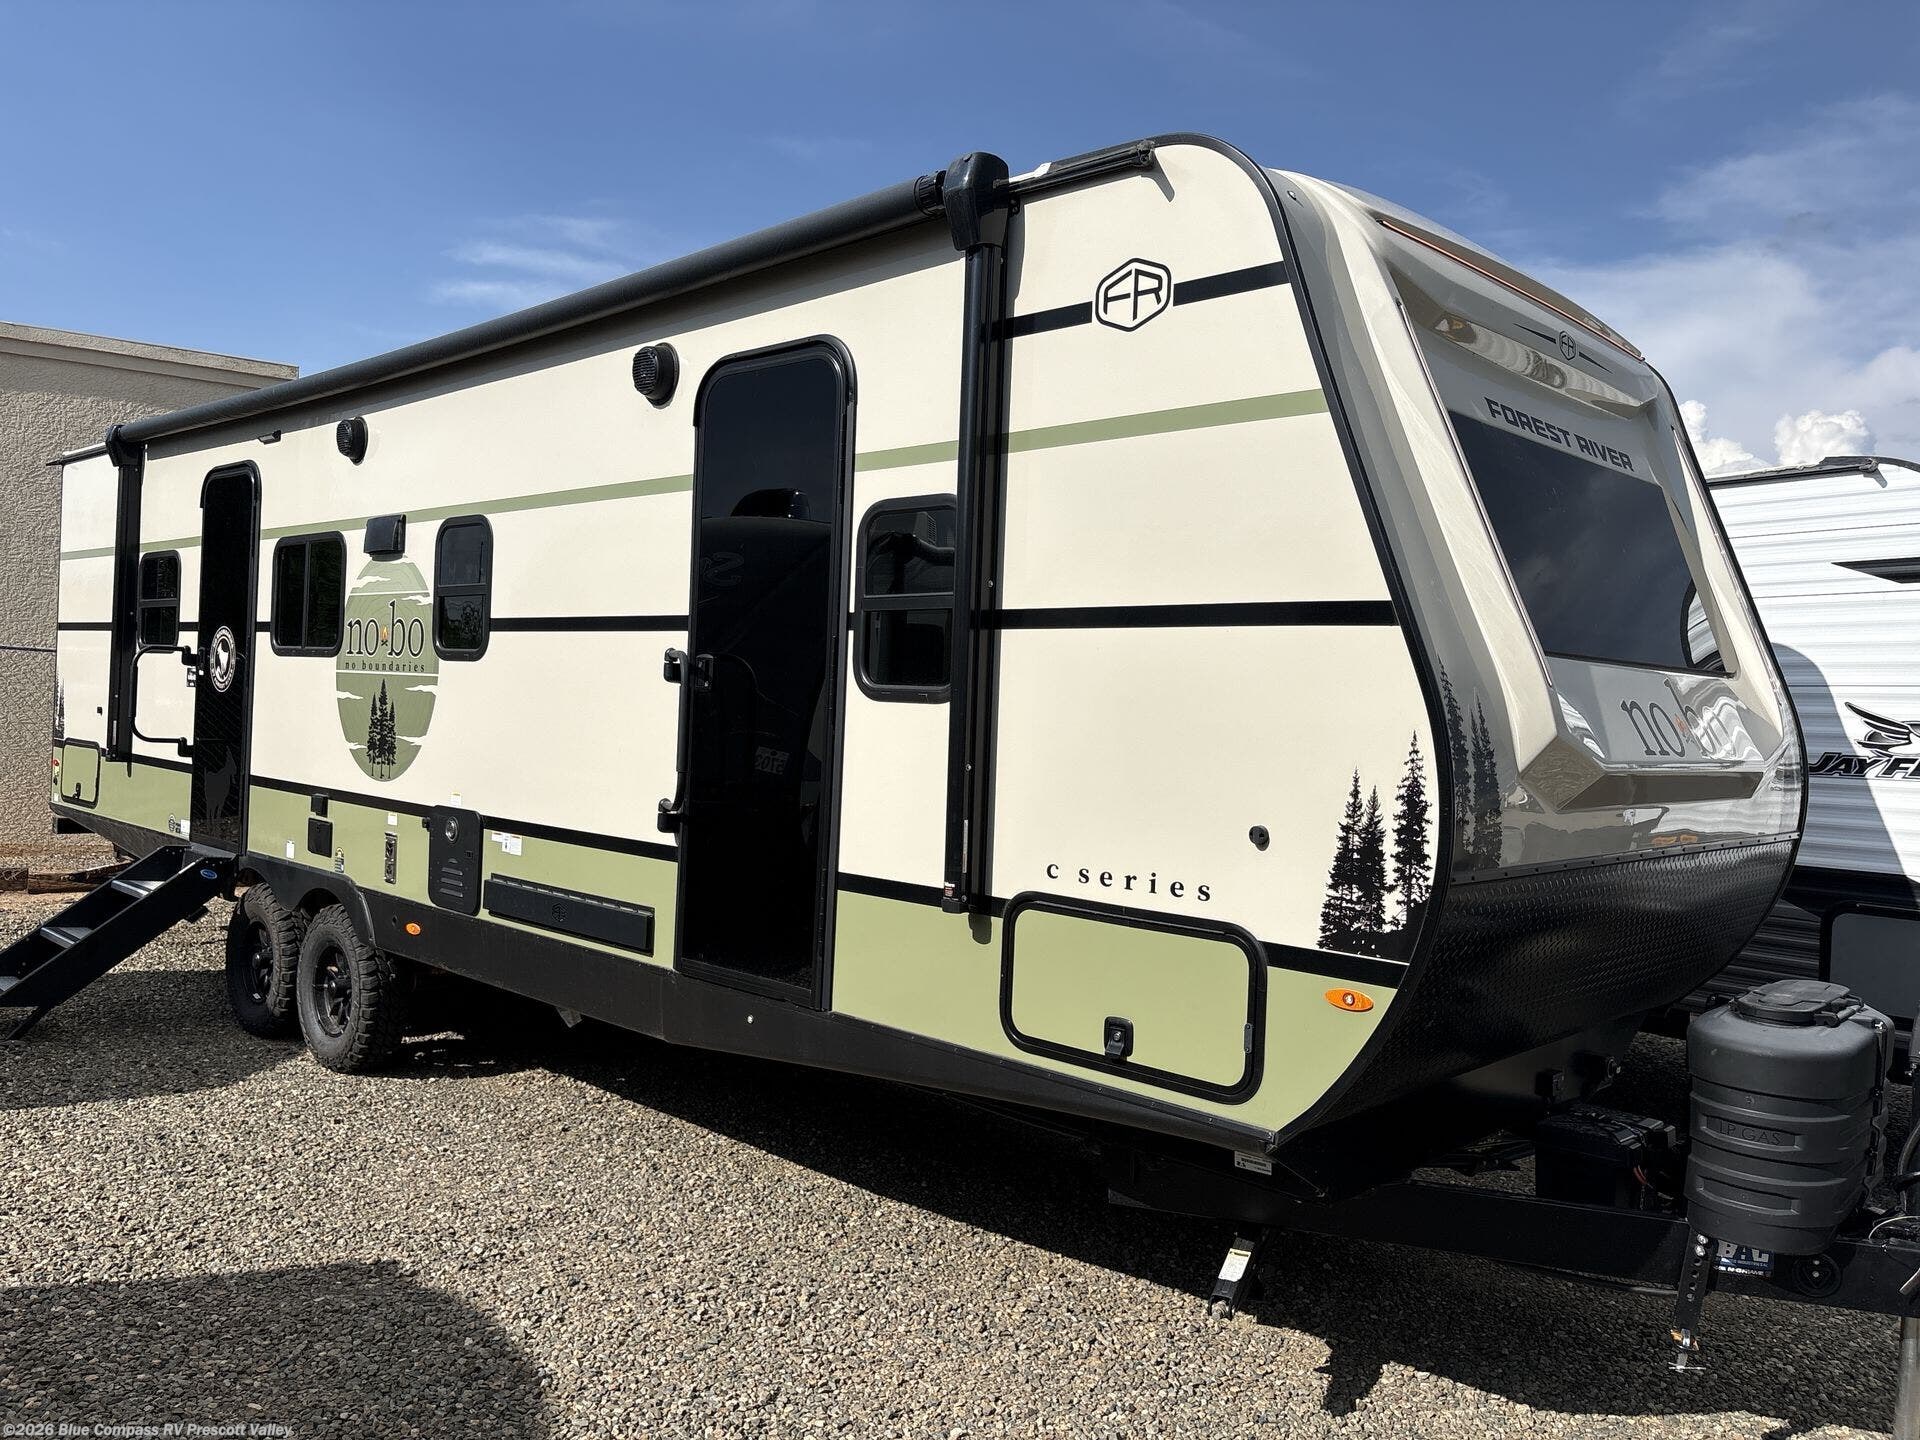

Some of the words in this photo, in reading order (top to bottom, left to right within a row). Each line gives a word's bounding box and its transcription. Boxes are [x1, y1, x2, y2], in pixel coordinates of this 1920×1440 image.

[1102, 265, 1164, 323] FR
[1484, 397, 1572, 447] FOREST
[1574, 433, 1635, 472] RIVER
[345, 661, 356, 670] no
[362, 660, 425, 673] boundaries
[1809, 752, 1885, 778] JAY
[1046, 863, 1060, 880] c
[1078, 867, 1211, 902] series
[1719, 1120, 1737, 1136] LP
[1741, 1127, 1781, 1146] GAS
